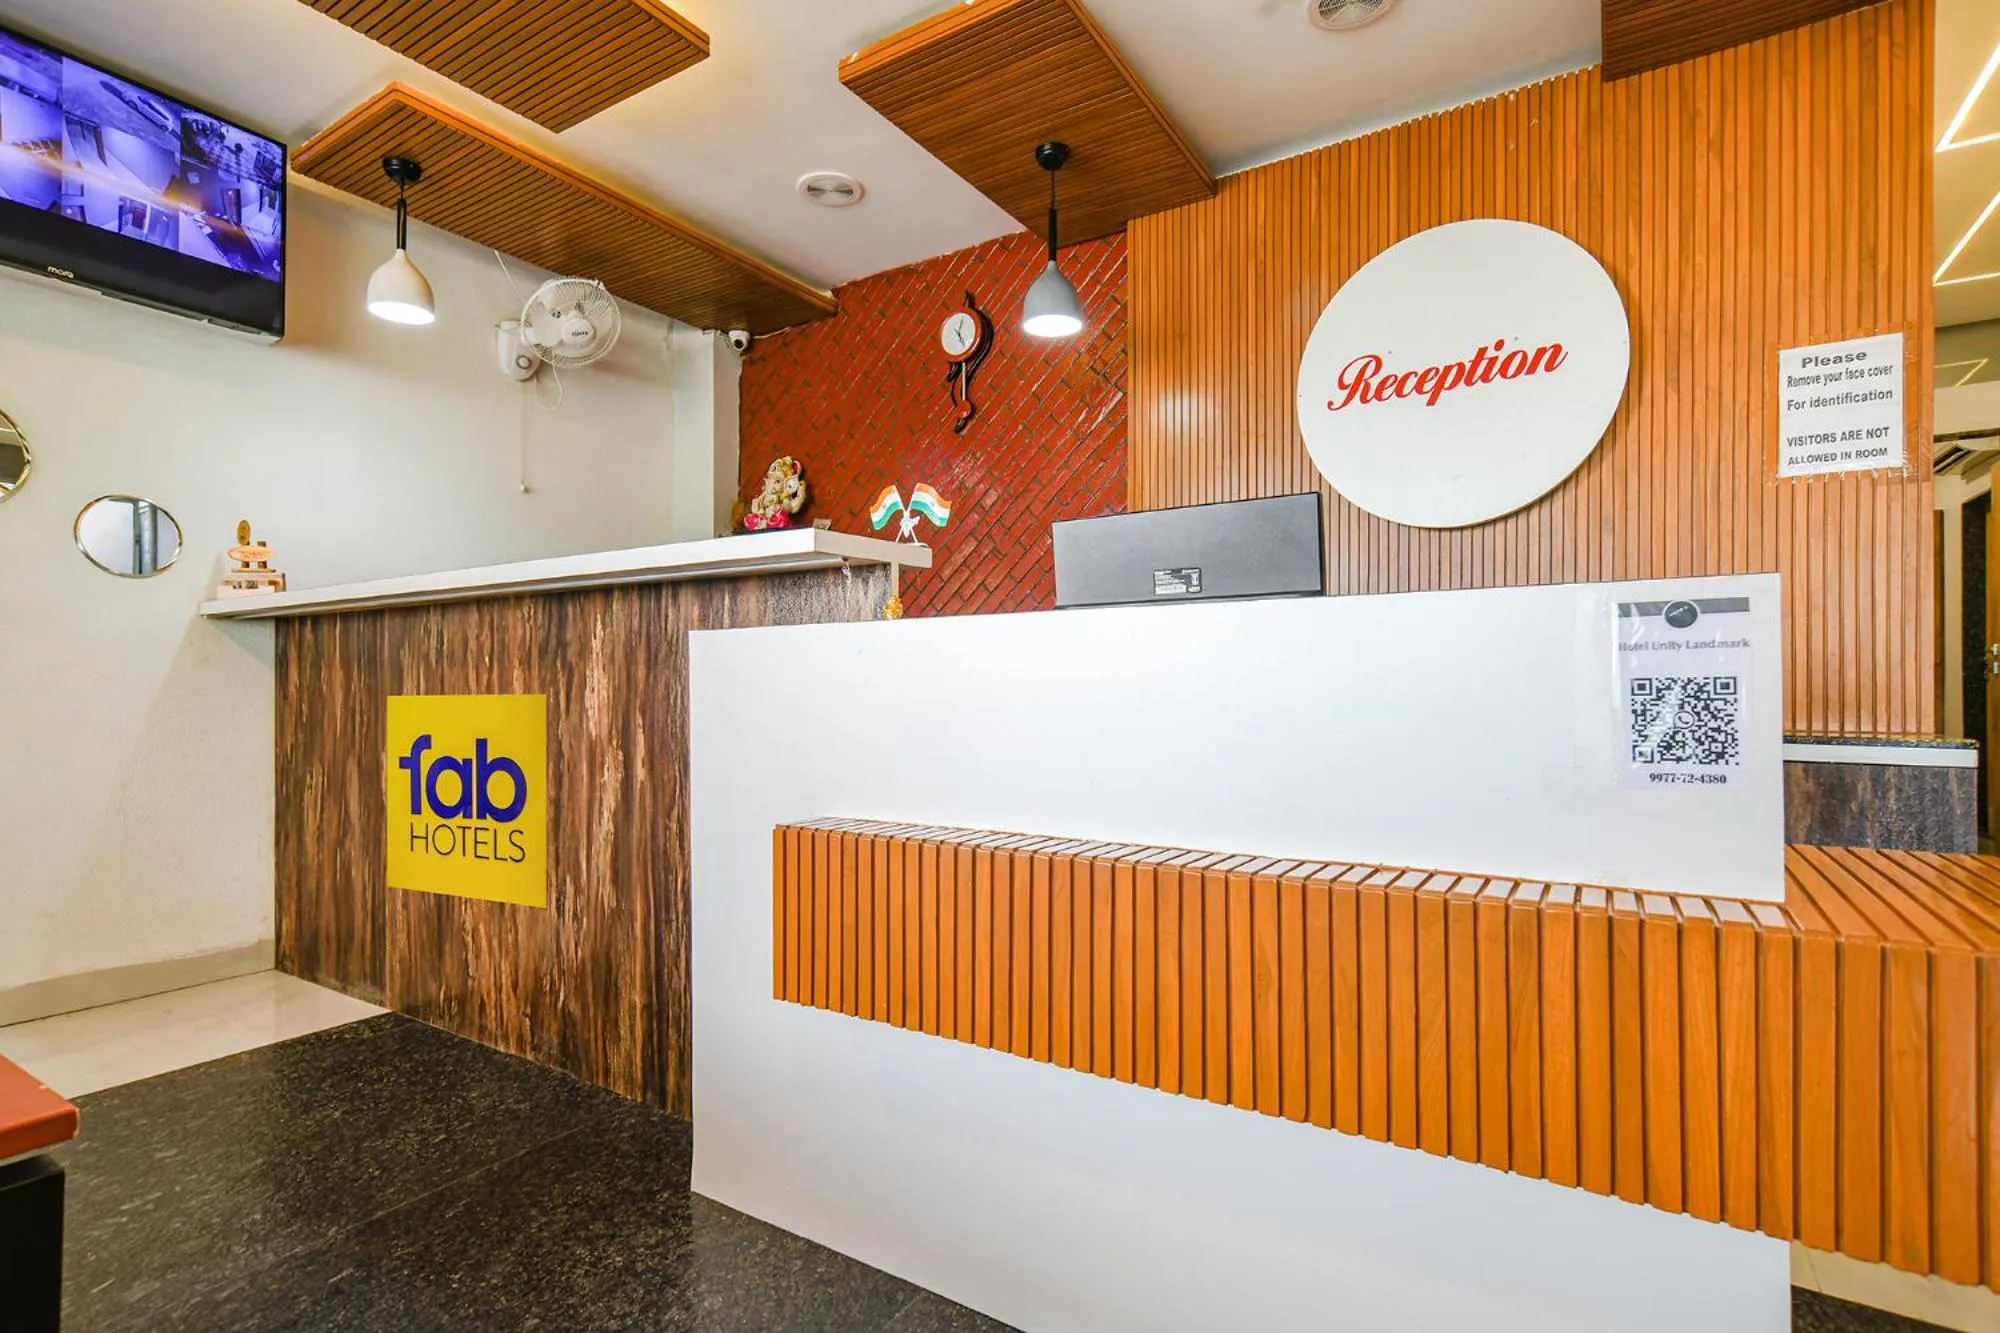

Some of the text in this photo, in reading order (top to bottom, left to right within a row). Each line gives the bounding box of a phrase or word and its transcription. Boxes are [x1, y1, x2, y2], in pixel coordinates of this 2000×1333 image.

[1801, 351, 1867, 368] Please
[1327, 338, 1569, 411] Reception
[1787, 364, 1893, 388] Remove your face cover
[1787, 389, 1893, 411] For identification
[1787, 426, 1890, 447] VISITORS ARE NOT
[1788, 447, 1888, 465] ALLOWED IN ROOM
[1618, 641, 1649, 652] Hotel
[1652, 640, 1682, 653] Unity
[398, 734, 527, 823] fab
[1649, 772, 1727, 784] 9977-72-4380
[410, 822, 526, 863] HOTELS
